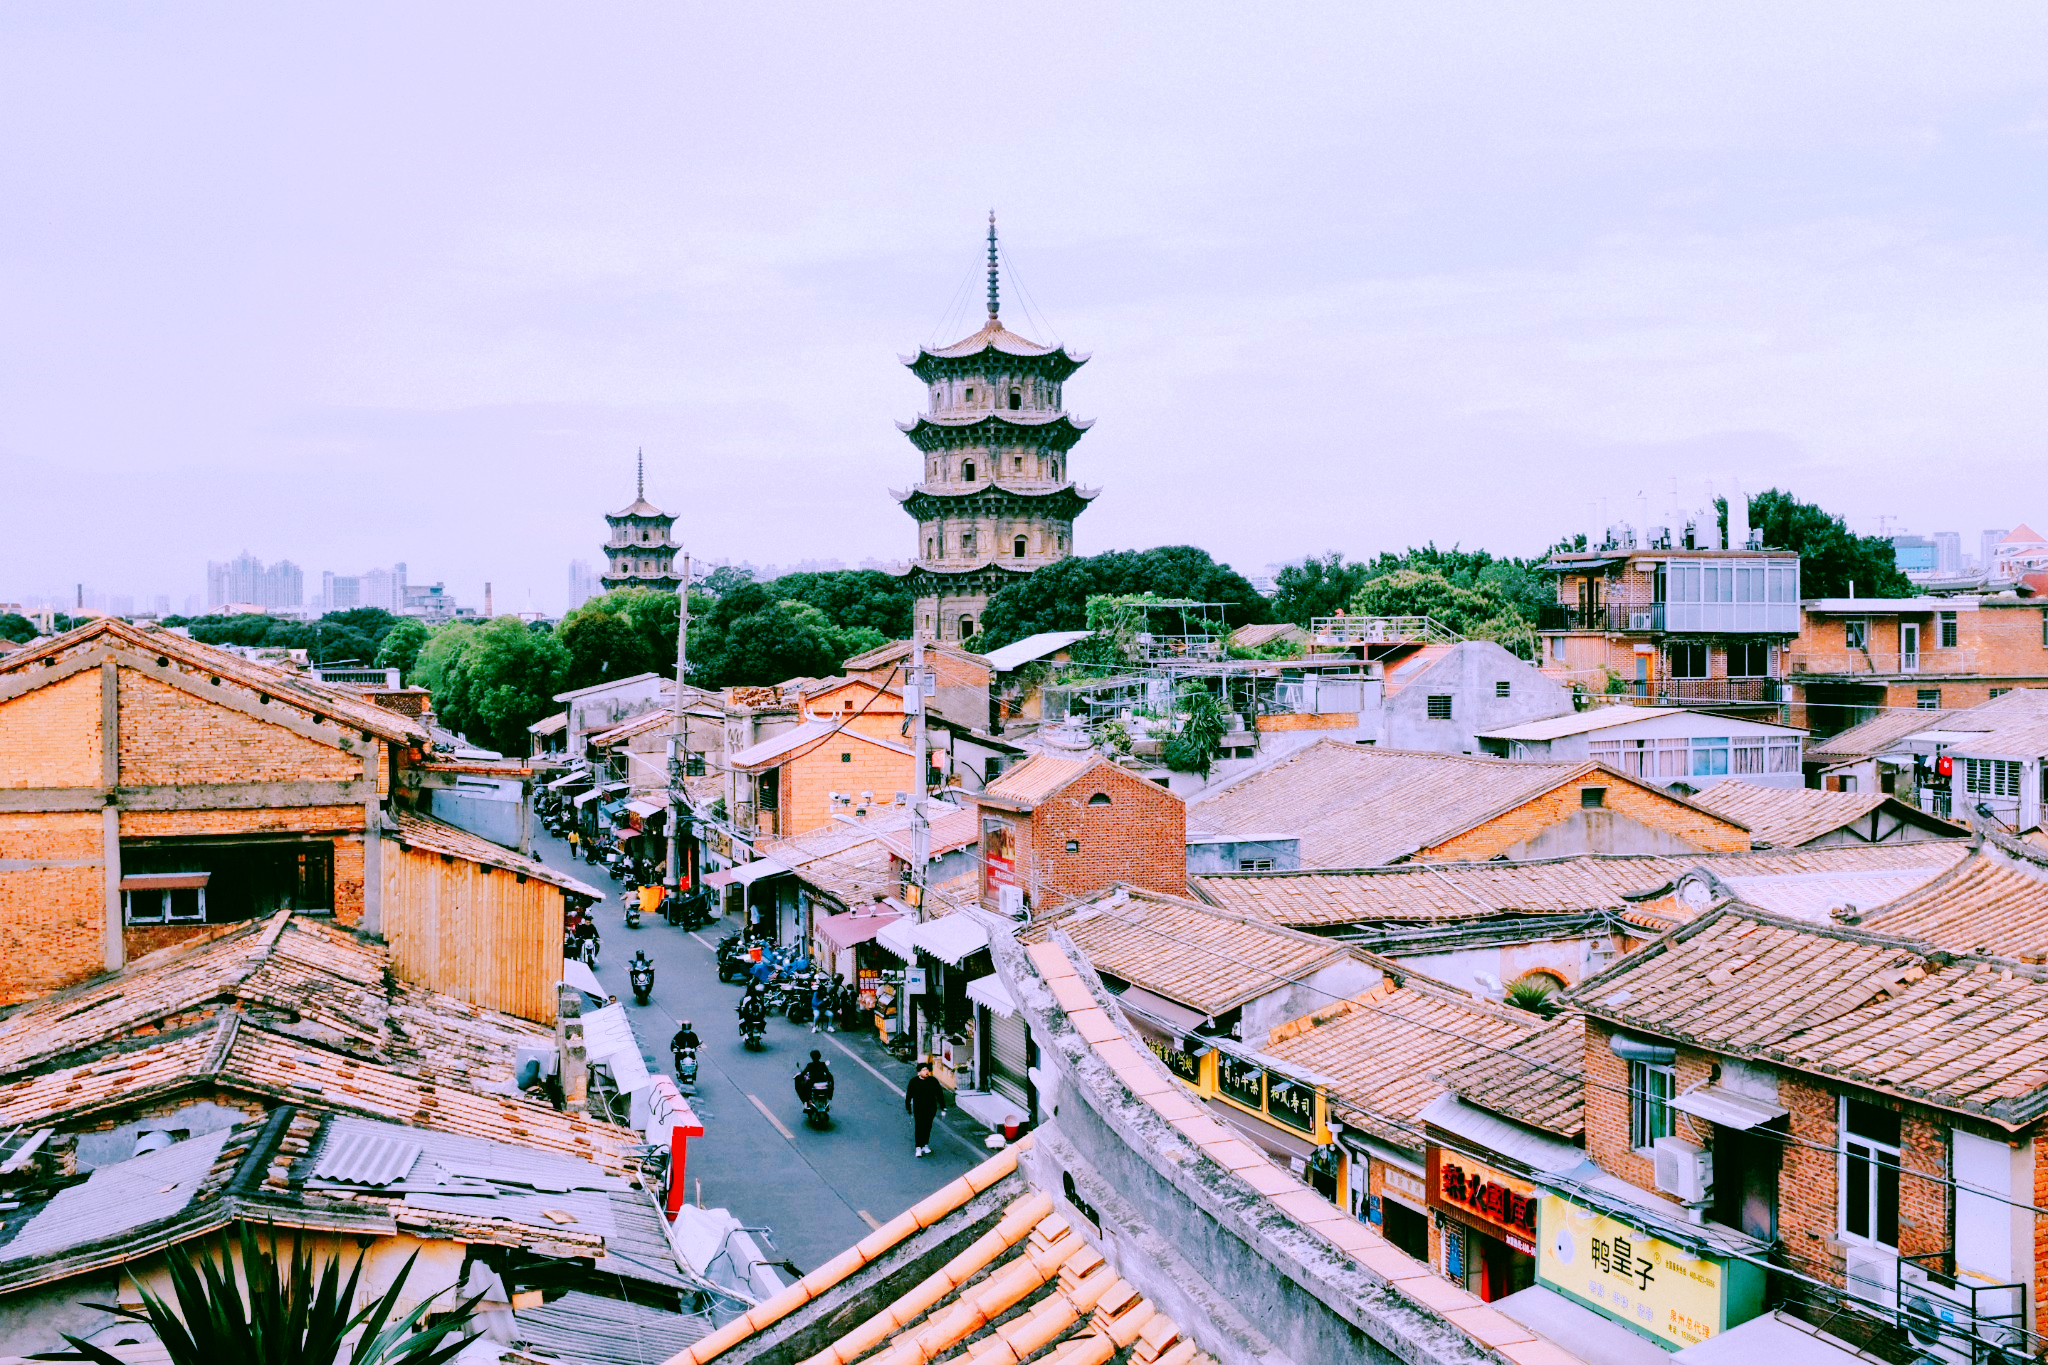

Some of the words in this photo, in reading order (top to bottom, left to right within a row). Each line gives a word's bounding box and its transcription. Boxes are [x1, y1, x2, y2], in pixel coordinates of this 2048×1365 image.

[1592, 1236, 1654, 1291] 鸭皇子
[1670, 1309, 1710, 1339] 泉州总代理
